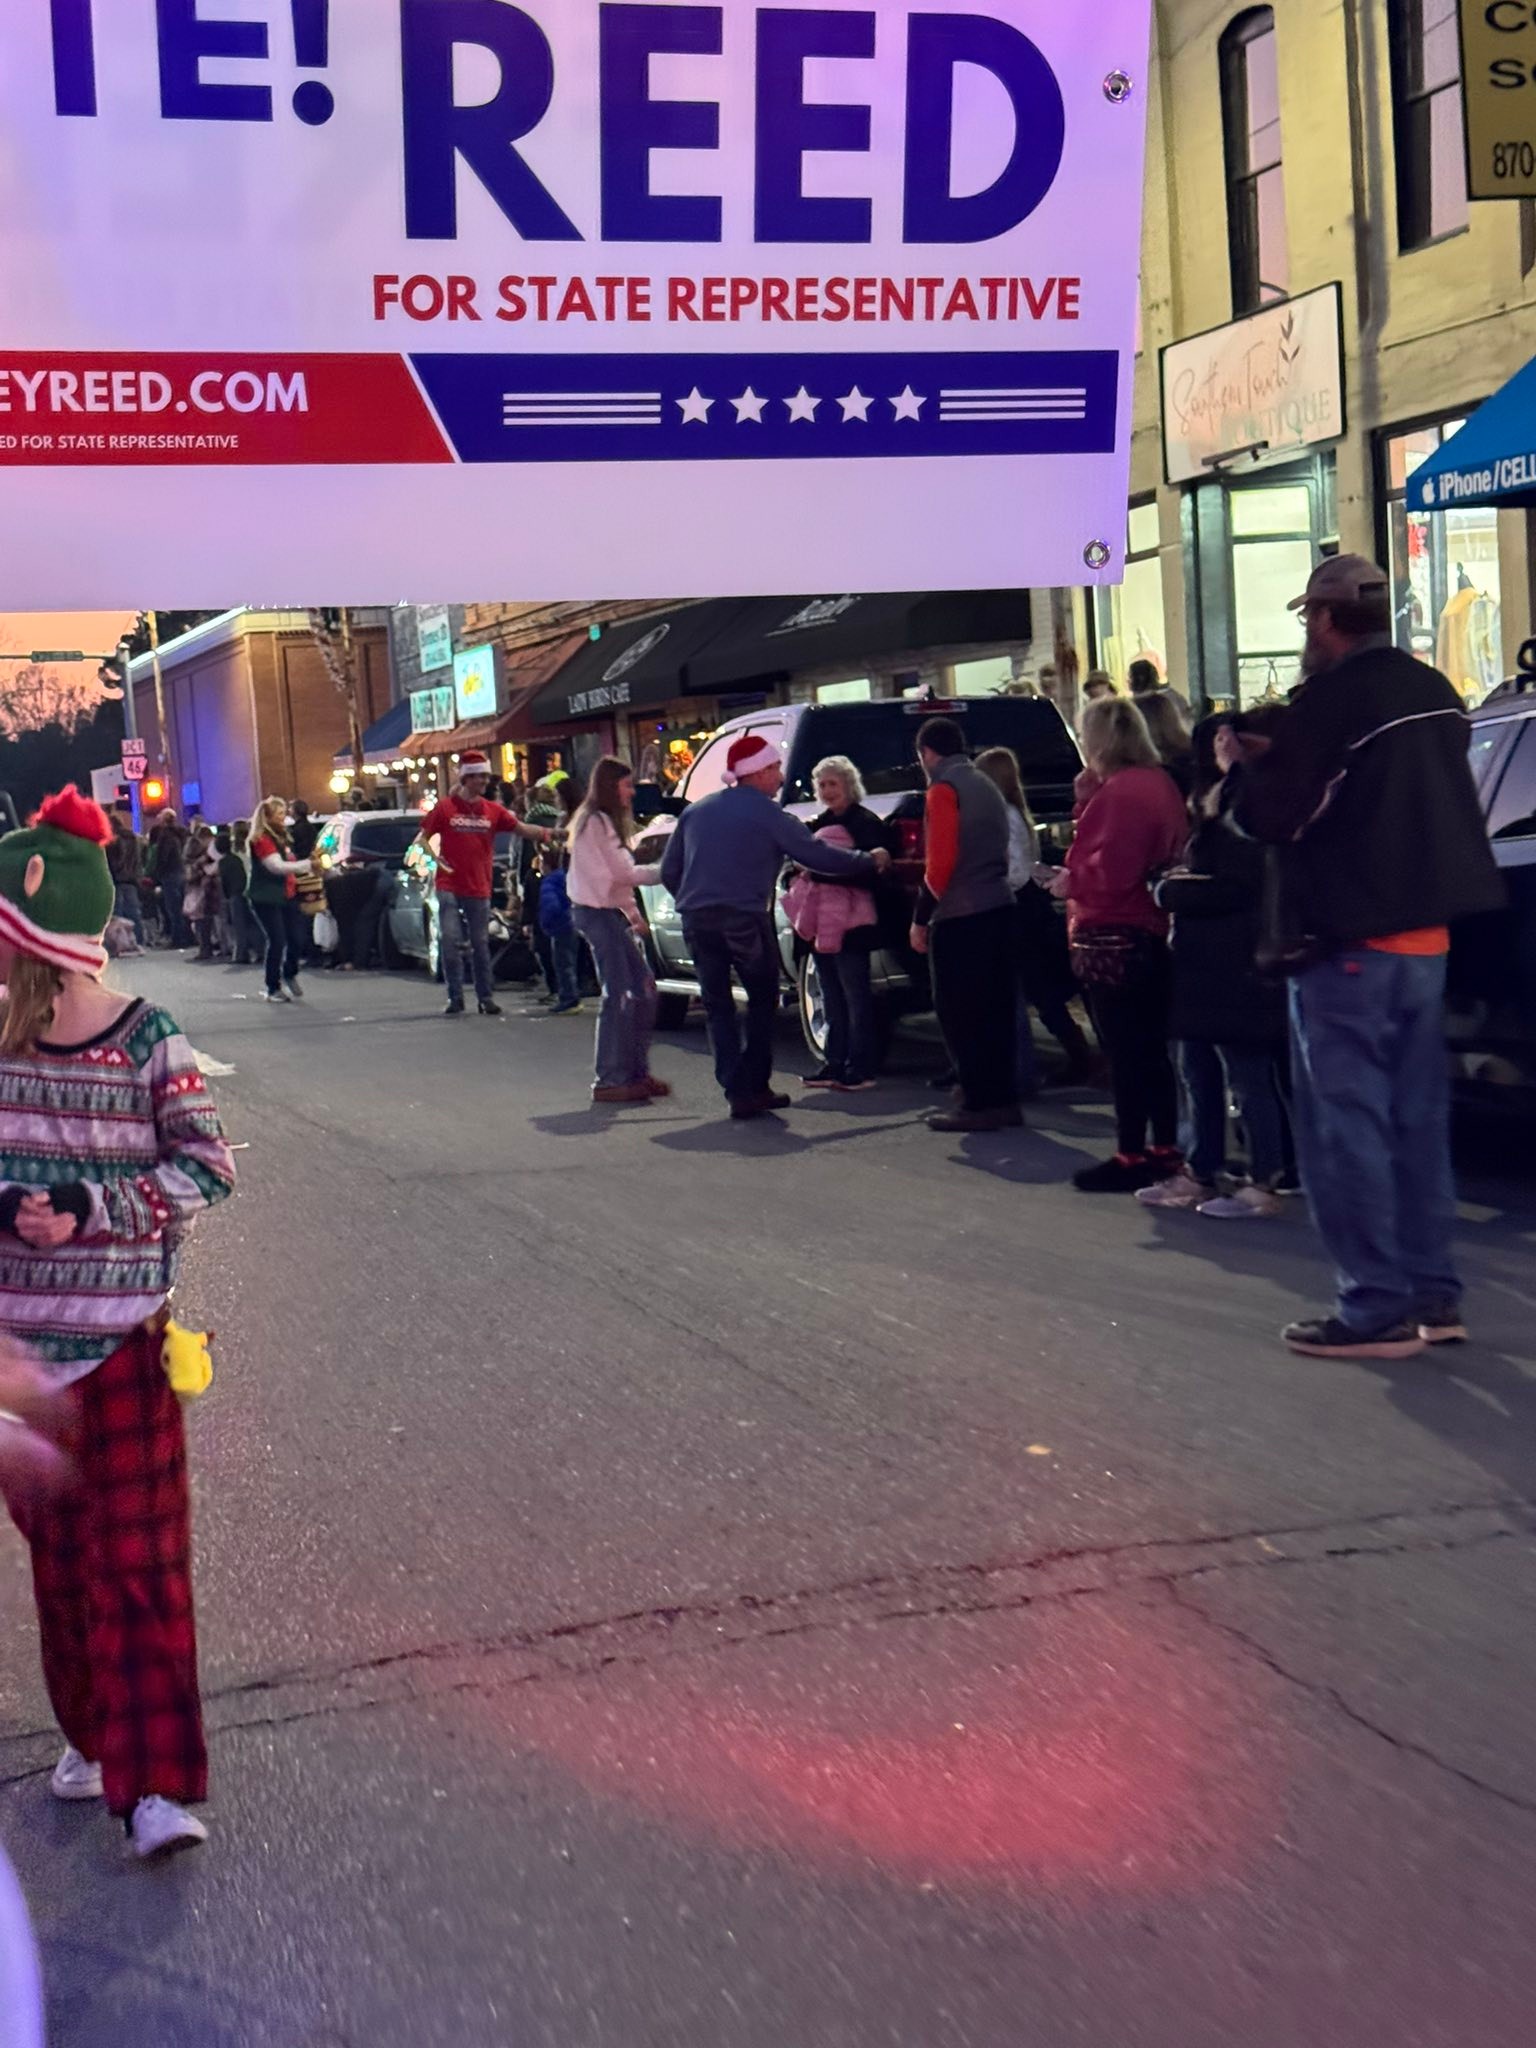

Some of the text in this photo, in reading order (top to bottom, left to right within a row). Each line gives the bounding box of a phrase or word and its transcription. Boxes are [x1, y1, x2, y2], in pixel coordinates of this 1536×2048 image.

[1484, 0, 1536, 34] C
[1488, 58, 1536, 90] S
[400, 0, 1066, 244] REED
[373, 274, 1081, 322] FOR STATE REPRESENTATIVE
[21, 434, 54, 449] FOR
[58, 434, 105, 449] STATE
[109, 434, 239, 449] REPRESENTATIVE
